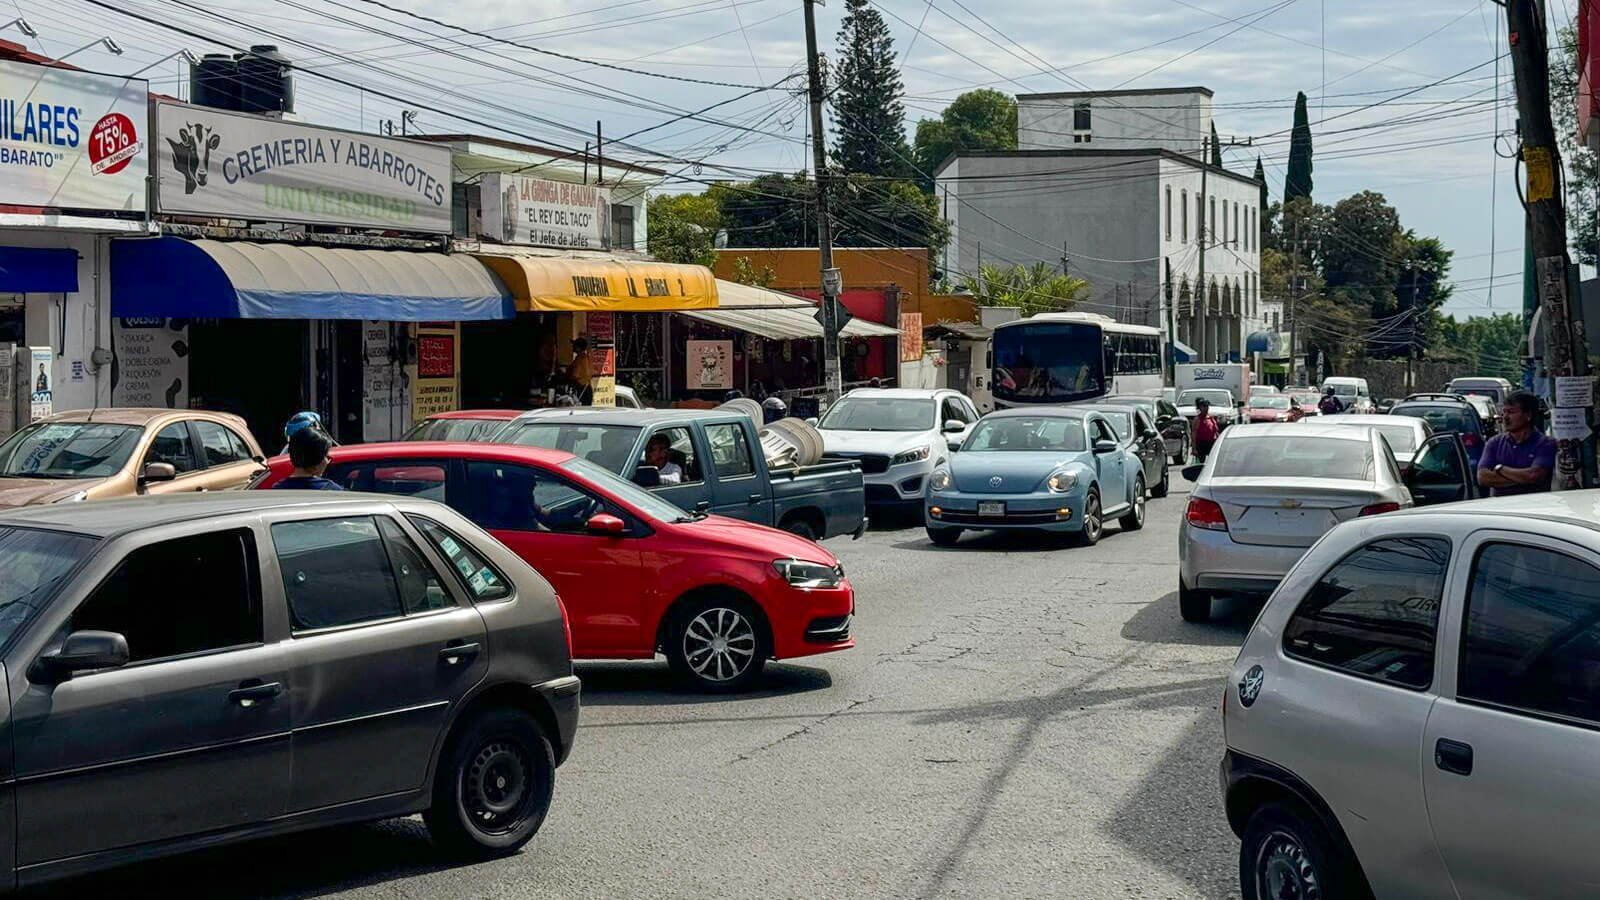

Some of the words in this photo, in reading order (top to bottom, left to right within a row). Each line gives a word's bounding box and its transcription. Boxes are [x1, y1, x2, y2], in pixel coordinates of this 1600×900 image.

[0, 98, 79, 148] ILARES
[97, 115, 118, 130] HASTA
[94, 121, 129, 158] 75%
[96, 161, 106, 171] DE
[109, 145, 136, 165] AHORRO
[222, 138, 327, 185] CREMERIA
[329, 138, 341, 164] Y
[345, 140, 445, 207] ABARROTES
[263, 183, 416, 222] UNIVERSIDAD
[521, 178, 530, 200] LA
[560, 184, 570, 205] DE
[539, 209, 554, 225] REY
[554, 210, 568, 226] DEL
[529, 229, 537, 243] El
[539, 230, 556, 245] Jefe
[557, 232, 568, 245] de
[569, 233, 589, 247] Jefes
[572, 275, 610, 297] TAQUERIA
[125, 335, 154, 343] OAXACA
